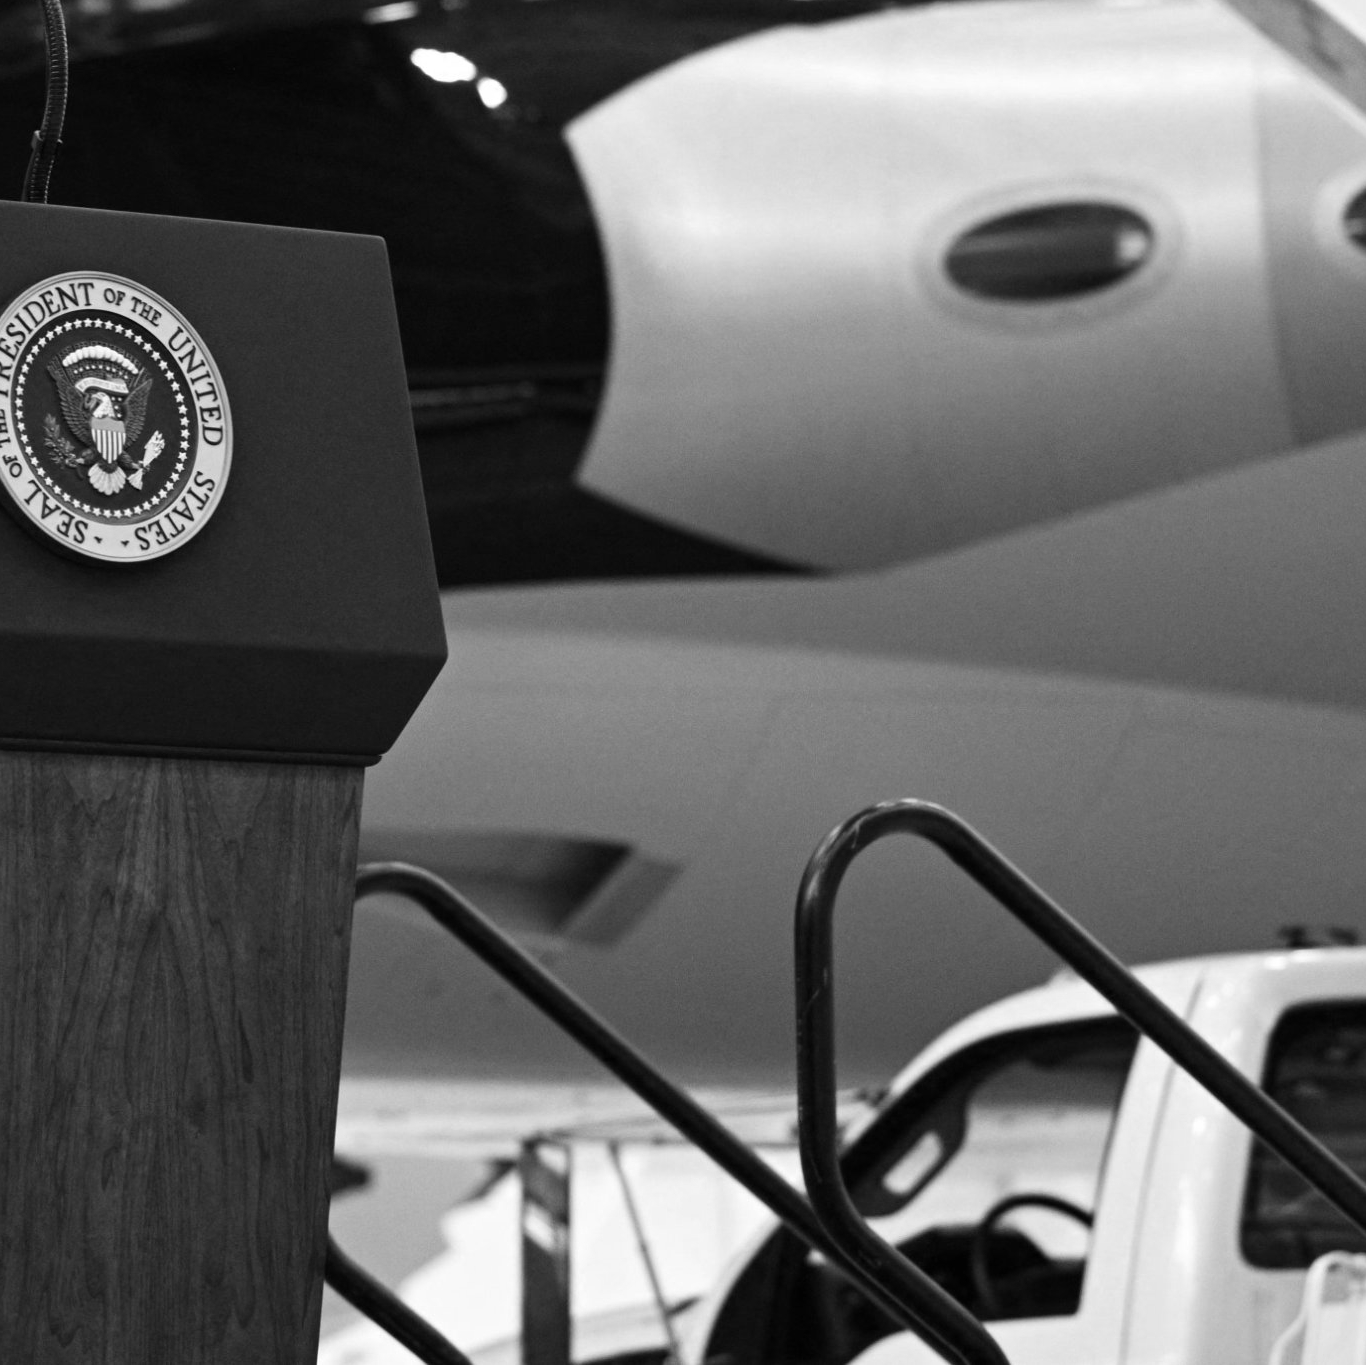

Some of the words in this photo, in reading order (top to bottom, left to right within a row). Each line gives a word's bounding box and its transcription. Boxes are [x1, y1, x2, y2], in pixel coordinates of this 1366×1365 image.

[103, 287, 127, 307] OF
[130, 296, 162, 327] THE
[167, 326, 224, 446] UNITED
[1, 452, 23, 478] OF
[23, 479, 89, 545] SEAL
[133, 470, 216, 551] STATES
